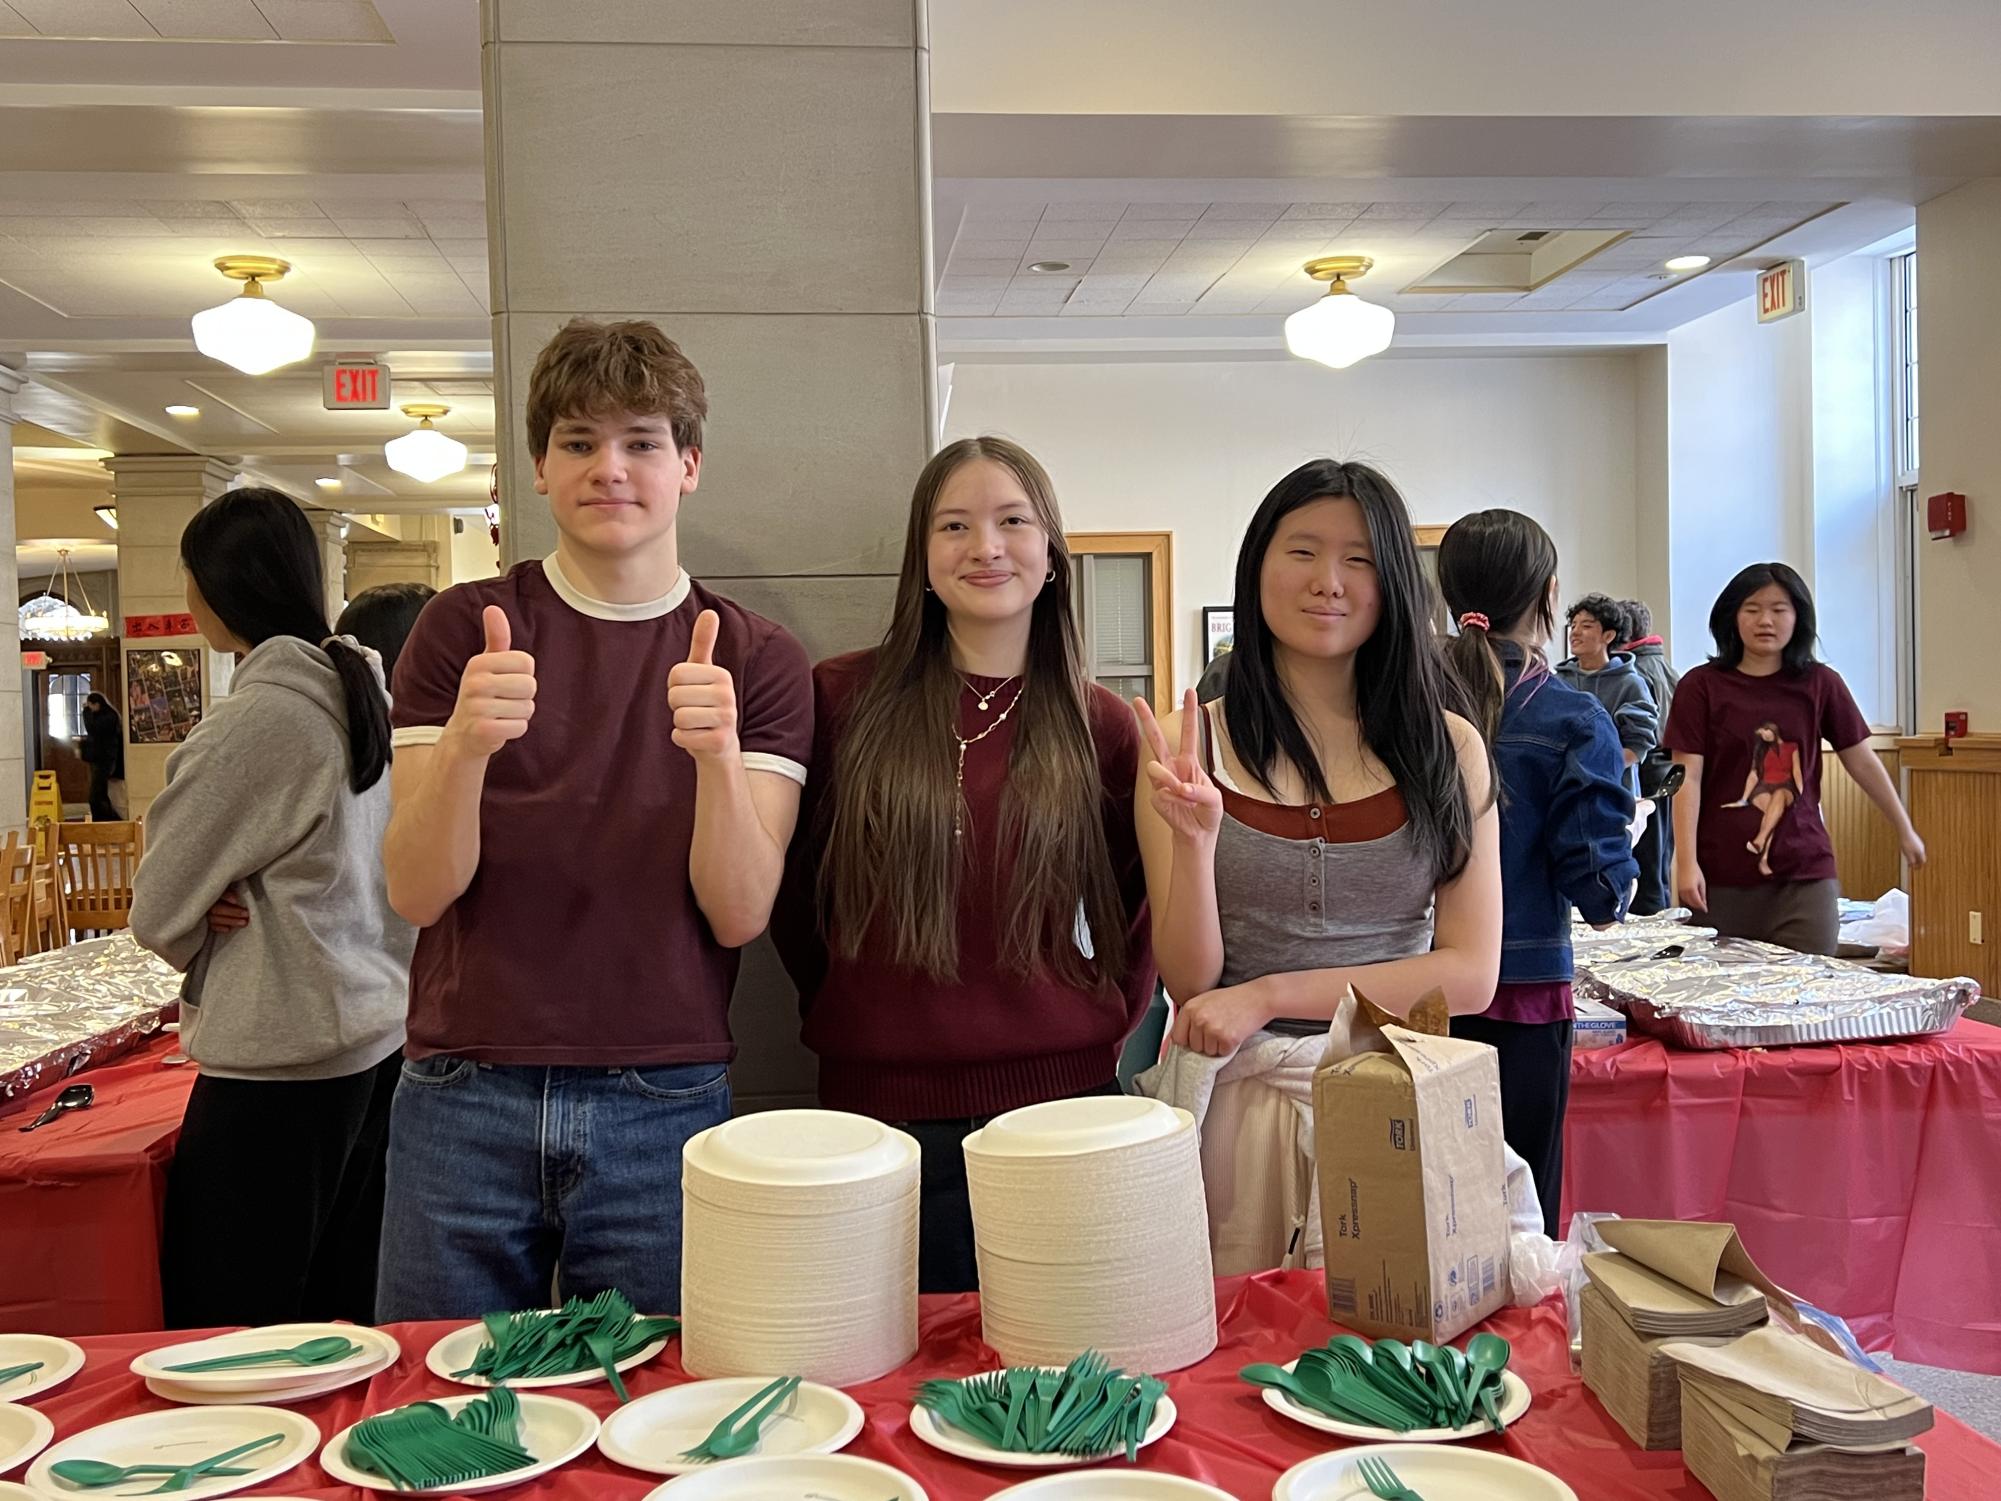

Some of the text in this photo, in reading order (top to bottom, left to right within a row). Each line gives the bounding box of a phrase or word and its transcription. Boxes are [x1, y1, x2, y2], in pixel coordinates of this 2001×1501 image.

[1762, 269, 1787, 315] EXIT
[336, 368, 378, 403] EXIT
[1394, 1120, 1404, 1149] TORK
[1339, 1214, 1347, 1237] Tork
